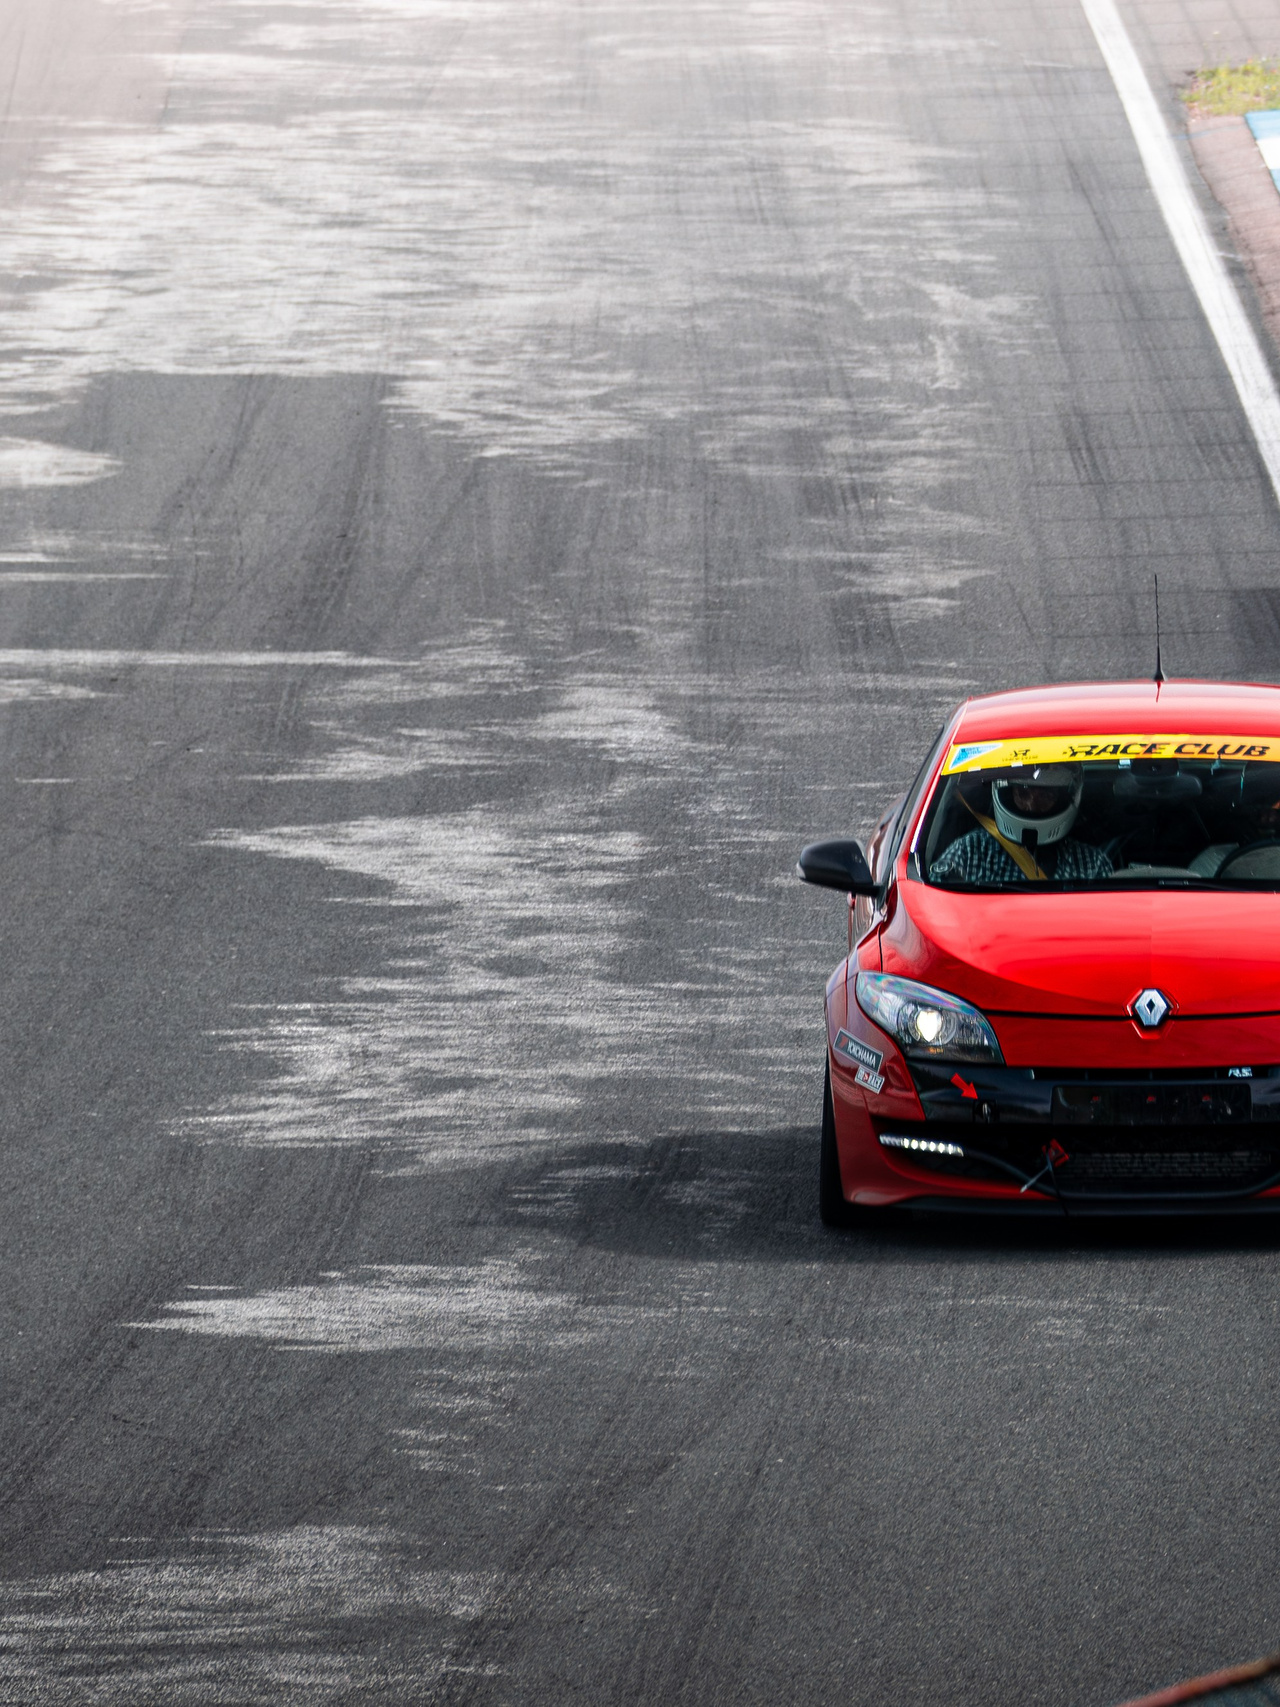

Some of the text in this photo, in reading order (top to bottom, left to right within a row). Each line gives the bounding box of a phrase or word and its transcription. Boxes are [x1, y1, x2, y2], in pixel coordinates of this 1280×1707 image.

[1063, 743, 1170, 758] RACE
[1173, 743, 1270, 757] CLUB
[847, 1039, 876, 1068] YOKOHAMA
